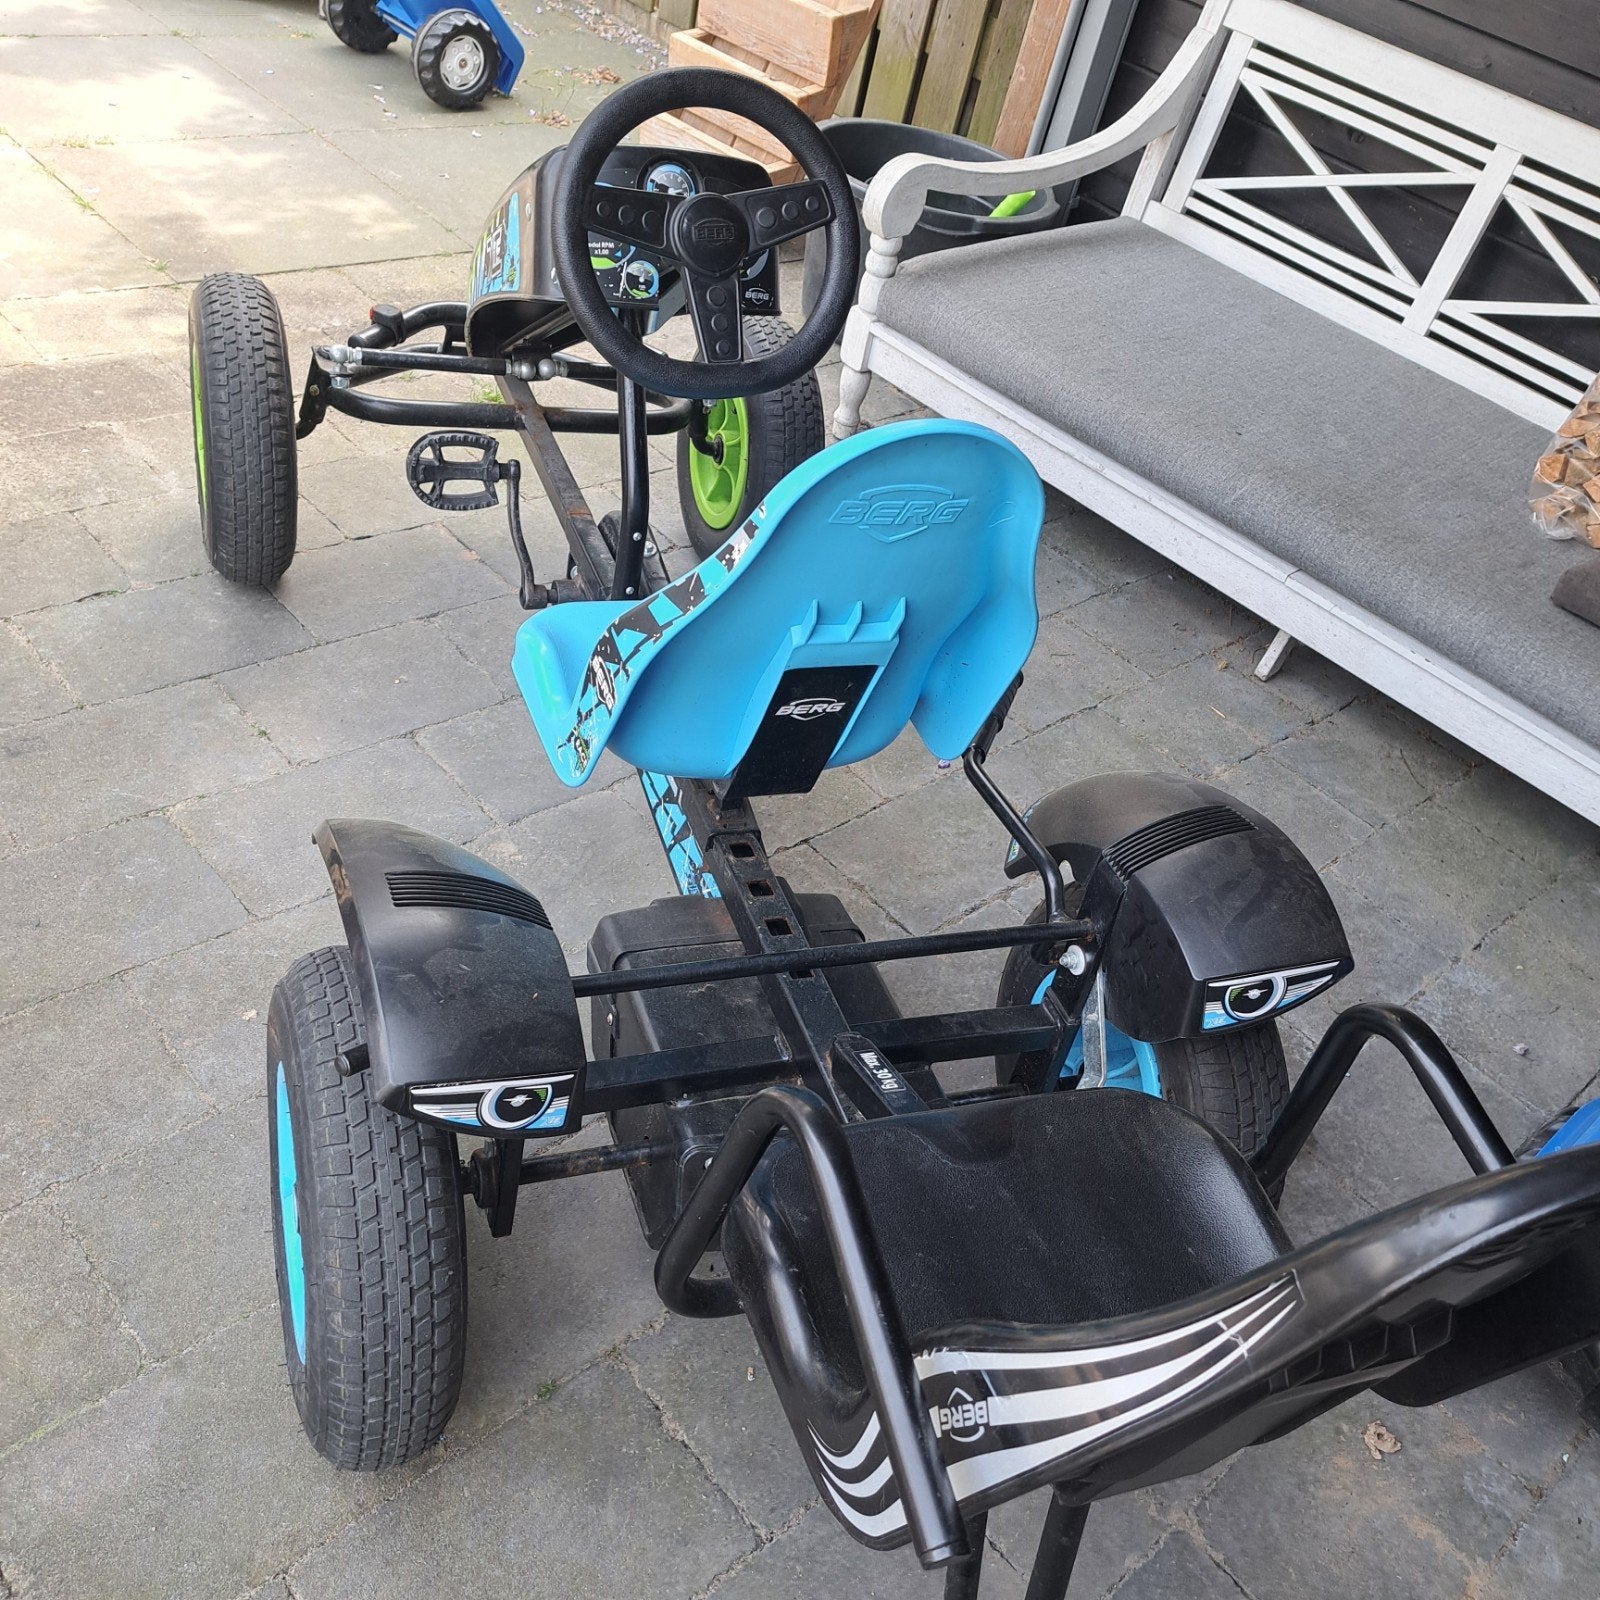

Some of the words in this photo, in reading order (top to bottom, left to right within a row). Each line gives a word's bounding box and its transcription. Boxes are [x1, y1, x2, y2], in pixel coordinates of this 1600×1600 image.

[692, 226, 735, 240] BERG
[744, 290, 769, 300] BERG
[829, 499, 969, 525] BERG
[591, 655, 614, 711] BERG
[775, 702, 846, 716] BERG
[860, 1052, 880, 1068] Max.
[873, 1068, 893, 1079] 30
[881, 1079, 899, 1089] kg
[940, 1400, 988, 1430] BERG
